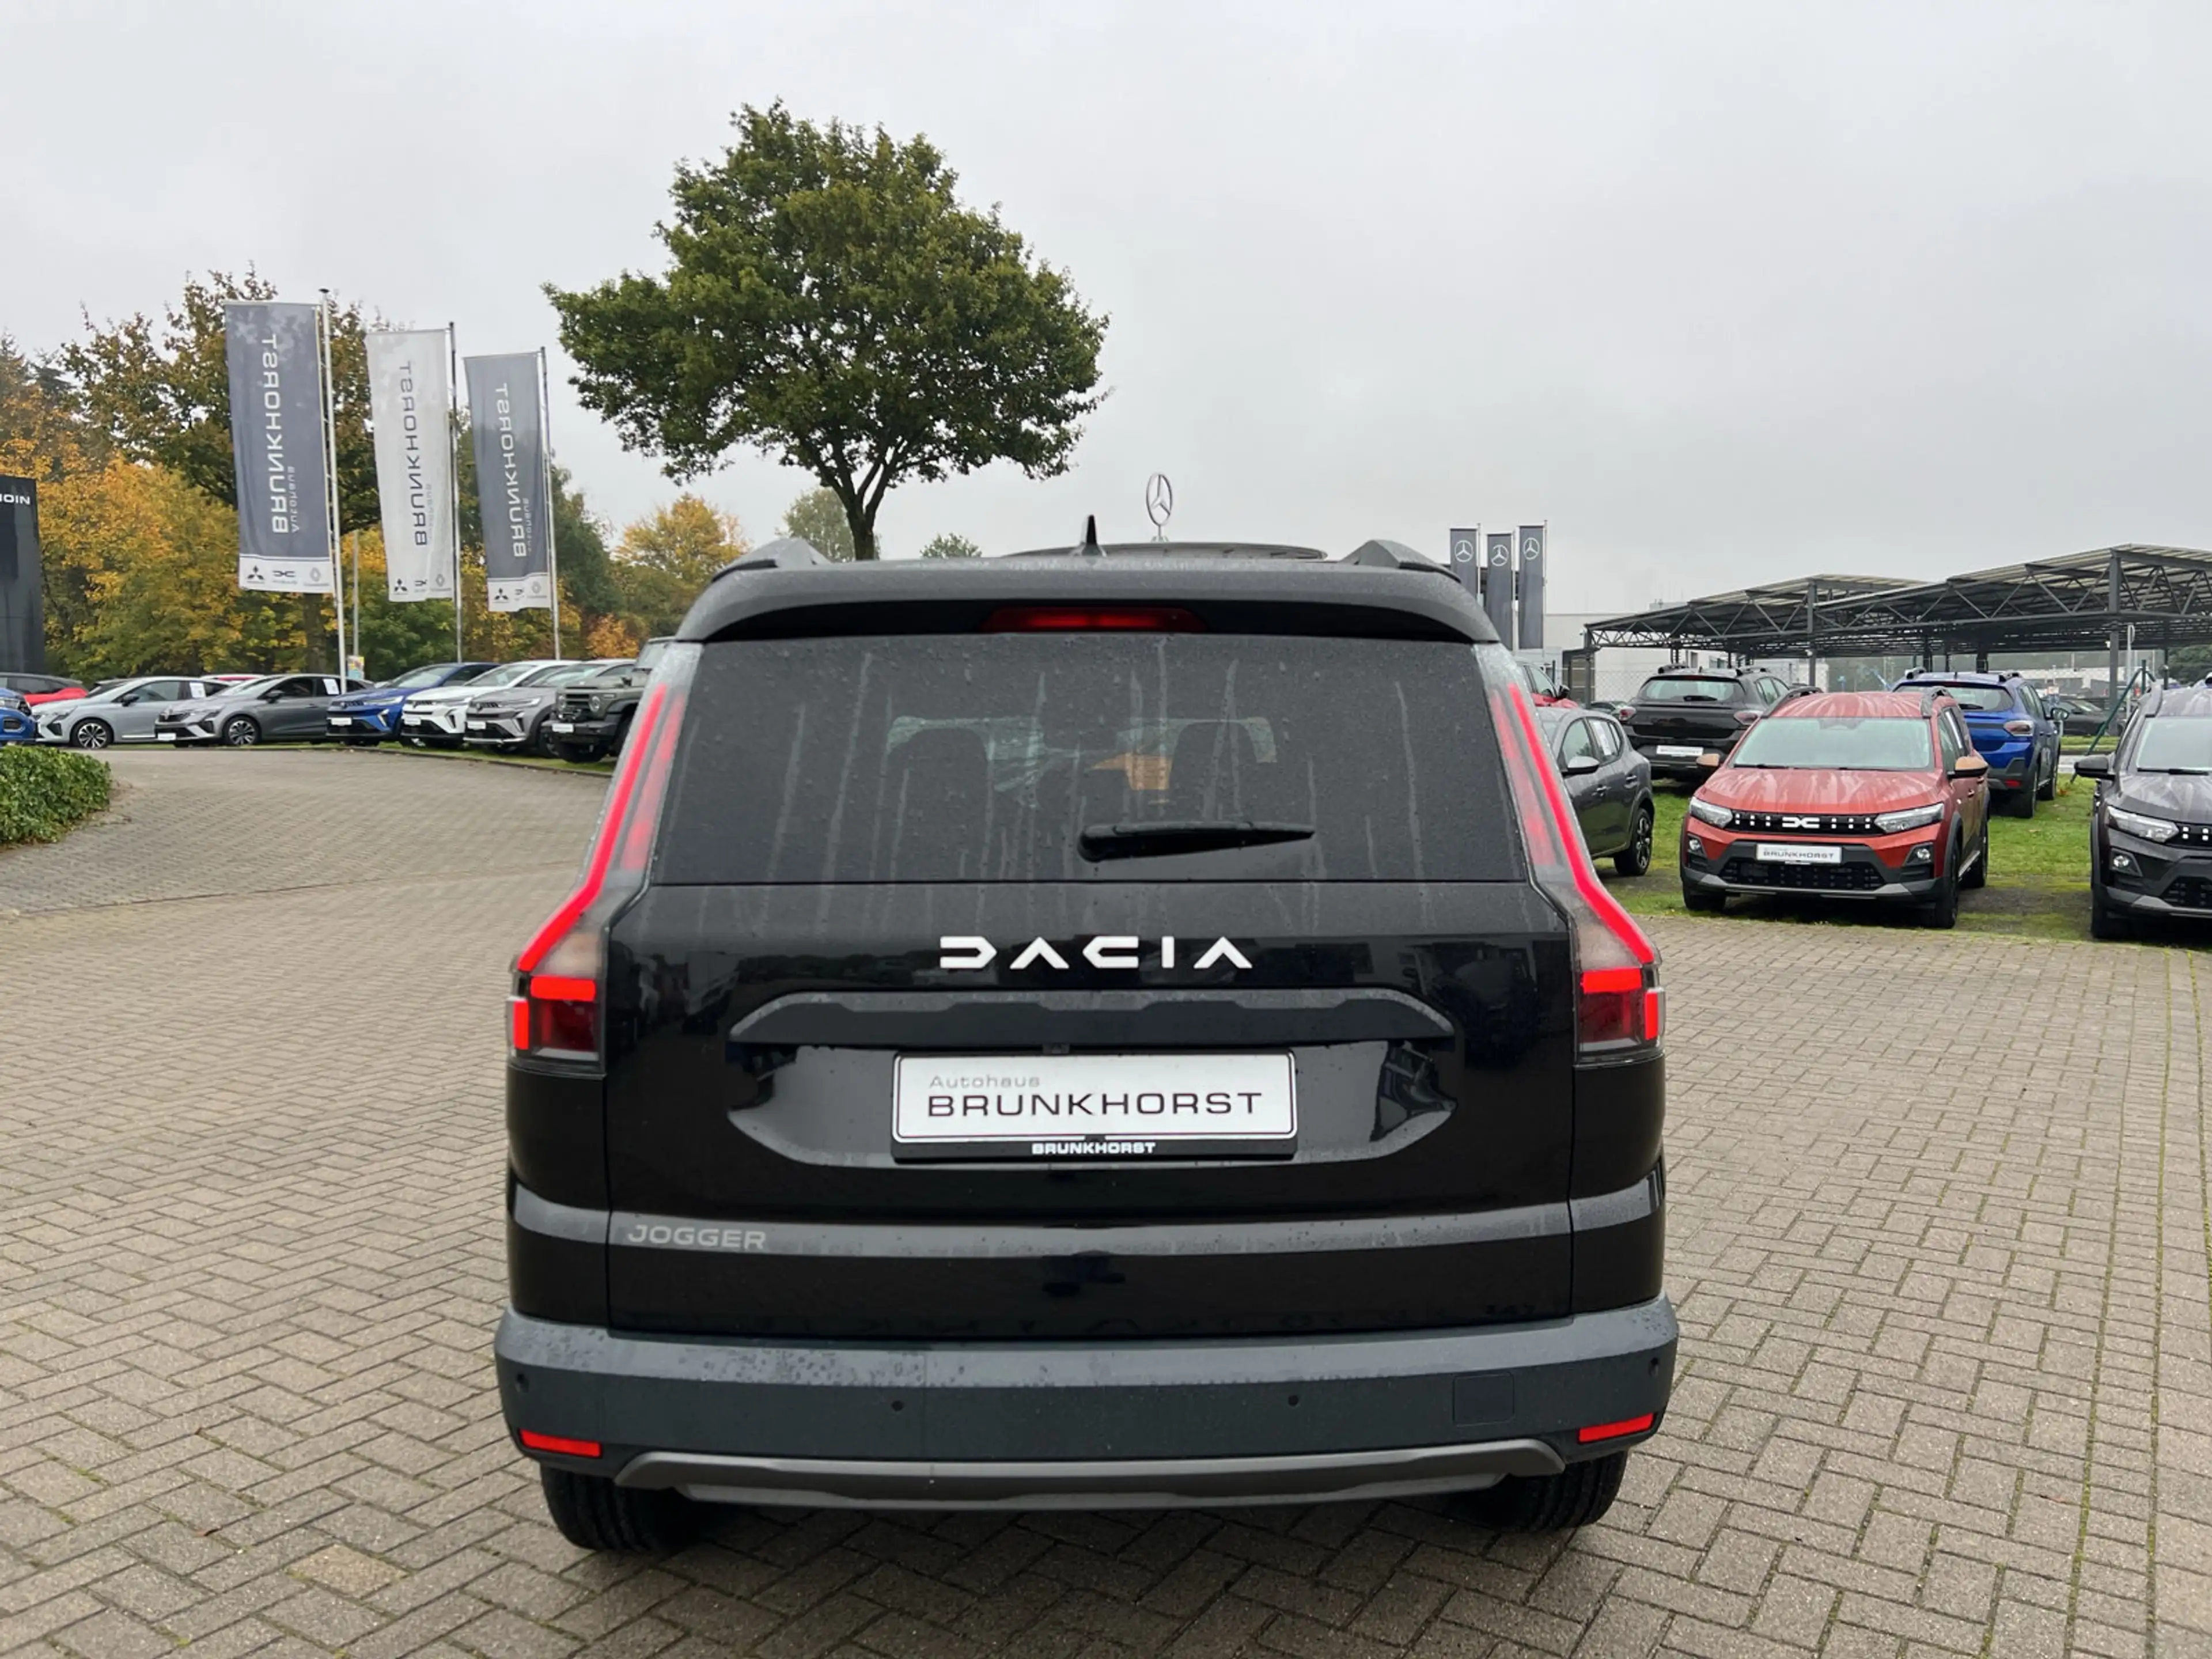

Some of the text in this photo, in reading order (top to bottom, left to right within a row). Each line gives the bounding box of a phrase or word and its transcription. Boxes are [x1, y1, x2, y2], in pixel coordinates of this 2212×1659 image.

[940, 935, 1253, 969] DACIA
[929, 1075, 1040, 1089] Autohaus
[927, 1092, 1262, 1117] BRUNKHORST
[1032, 1142, 1156, 1155] BRUNKHORST
[627, 1224, 767, 1250] JOGGER
